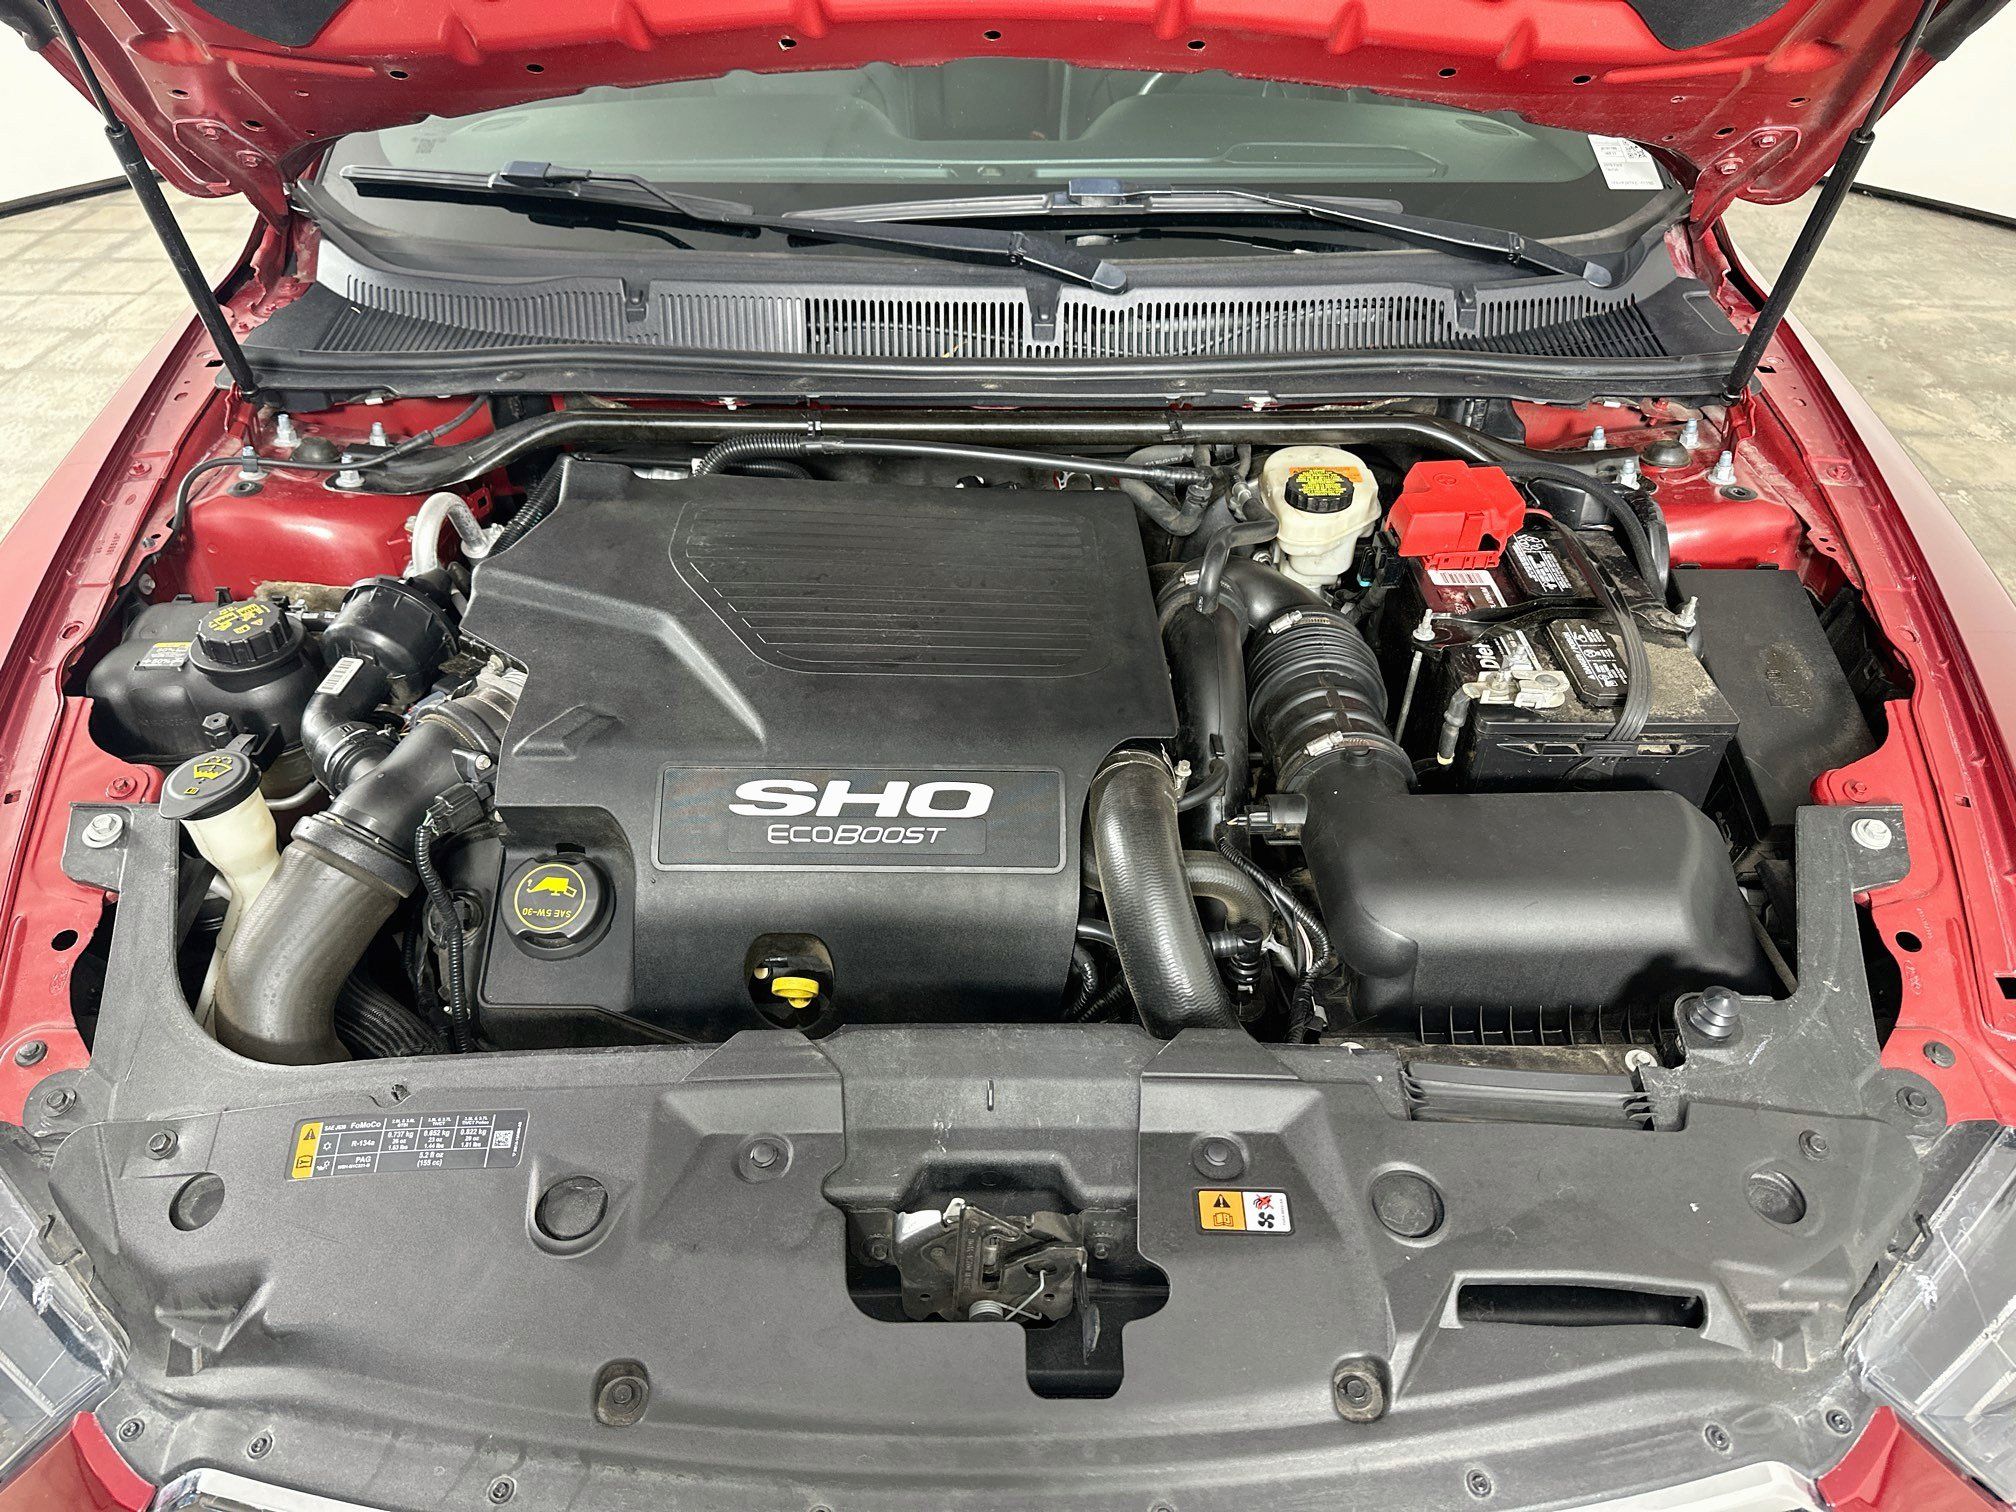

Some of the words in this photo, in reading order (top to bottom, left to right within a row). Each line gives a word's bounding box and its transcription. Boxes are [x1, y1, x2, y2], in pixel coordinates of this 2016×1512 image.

[728, 779, 995, 819] SHO
[522, 907, 552, 917] 5W-30
[553, 909, 573, 918] SAE
[324, 1124, 335, 1132] SAE
[350, 1120, 382, 1130] FoMoCo
[387, 1130, 405, 1139] 0.737
[405, 1130, 415, 1139] kg
[423, 1129, 441, 1137] 0.652
[441, 1129, 451, 1138] kg
[460, 1128, 478, 1136] 0.822
[478, 1128, 487, 1136] kg
[351, 1140, 376, 1148] R-134a
[419, 1151, 430, 1159] 5.2
[355, 1156, 372, 1164] PAG
[416, 1159, 432, 1168] (155
[431, 1158, 443, 1167] cc)
